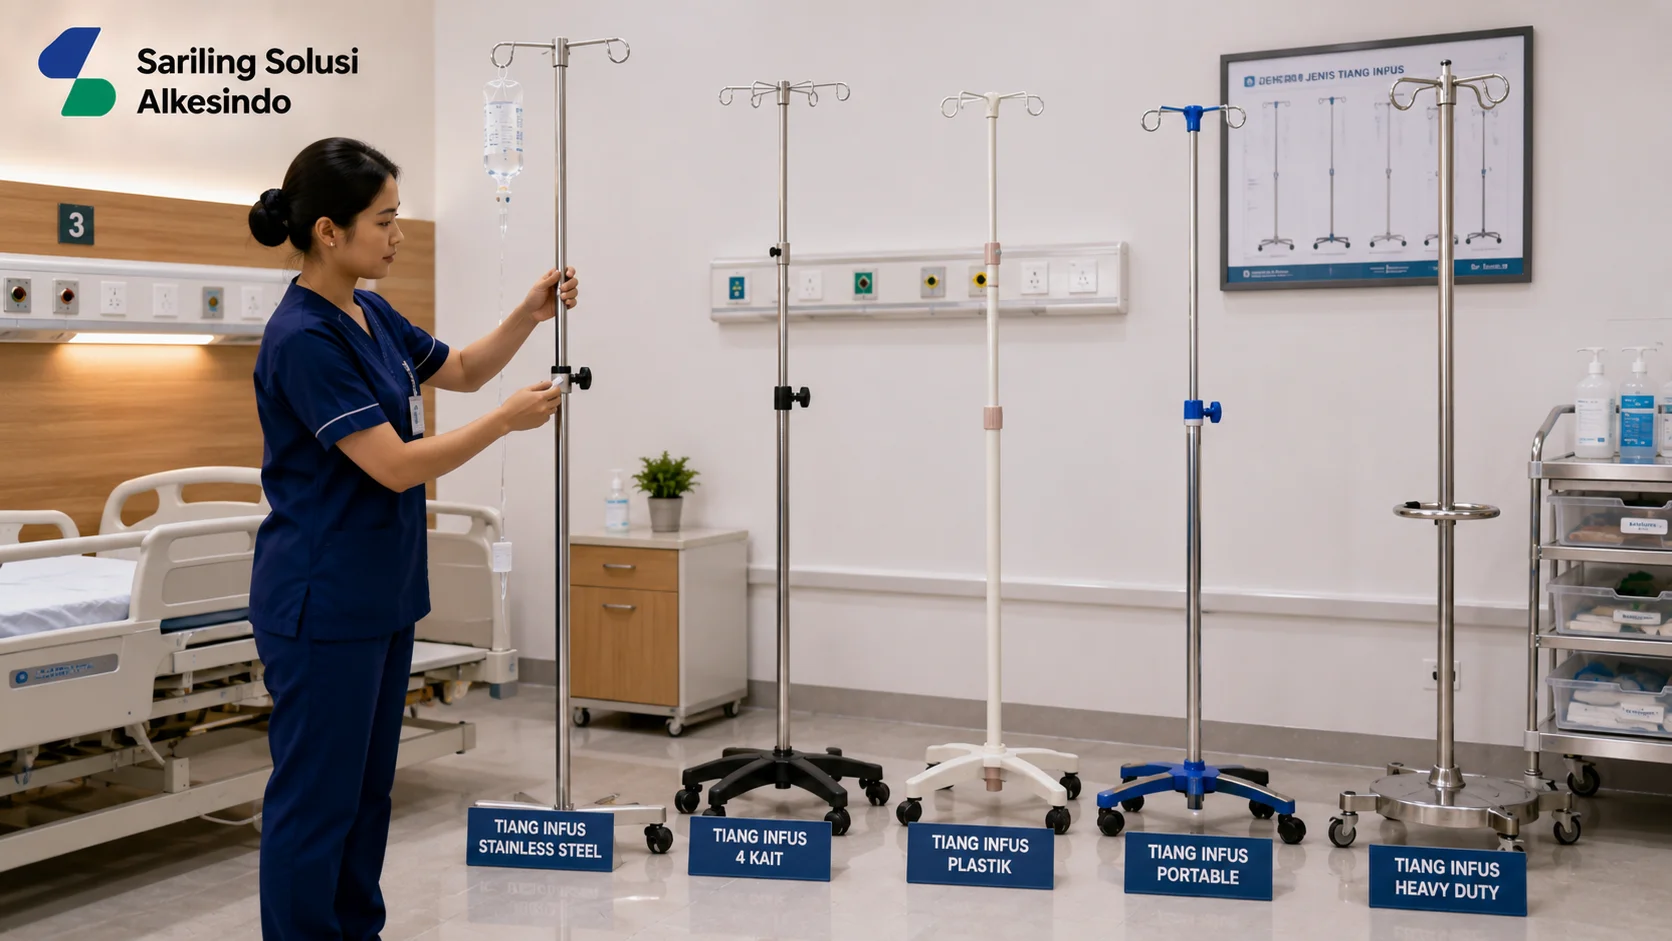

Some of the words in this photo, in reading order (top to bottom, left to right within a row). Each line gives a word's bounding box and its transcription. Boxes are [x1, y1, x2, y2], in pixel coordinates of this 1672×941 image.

[1304, 70, 1336, 82] JENIS
[1337, 67, 1370, 79] TIANG
[68, 211, 85, 238] 3
[493, 819, 539, 835] TIANG
[543, 821, 587, 837] INFUS
[712, 827, 759, 844] TIANG
[763, 830, 808, 846] INFUS
[478, 839, 555, 857] STAINLESS
[558, 843, 602, 859] STEEL
[931, 834, 979, 851] TIANG
[983, 837, 1030, 854] INFUS
[735, 850, 746, 865] 4
[749, 851, 784, 866] KAIT
[1147, 844, 1197, 861] TIANG
[1201, 846, 1249, 864] INFUS
[947, 857, 1012, 875] PLASTIK
[1157, 866, 1240, 885] PORTABLE
[1394, 857, 1446, 875] TIANG
[1450, 860, 1501, 878] INFUS
[1395, 879, 1450, 898] HEAVY
[1454, 882, 1500, 901] DUTY
